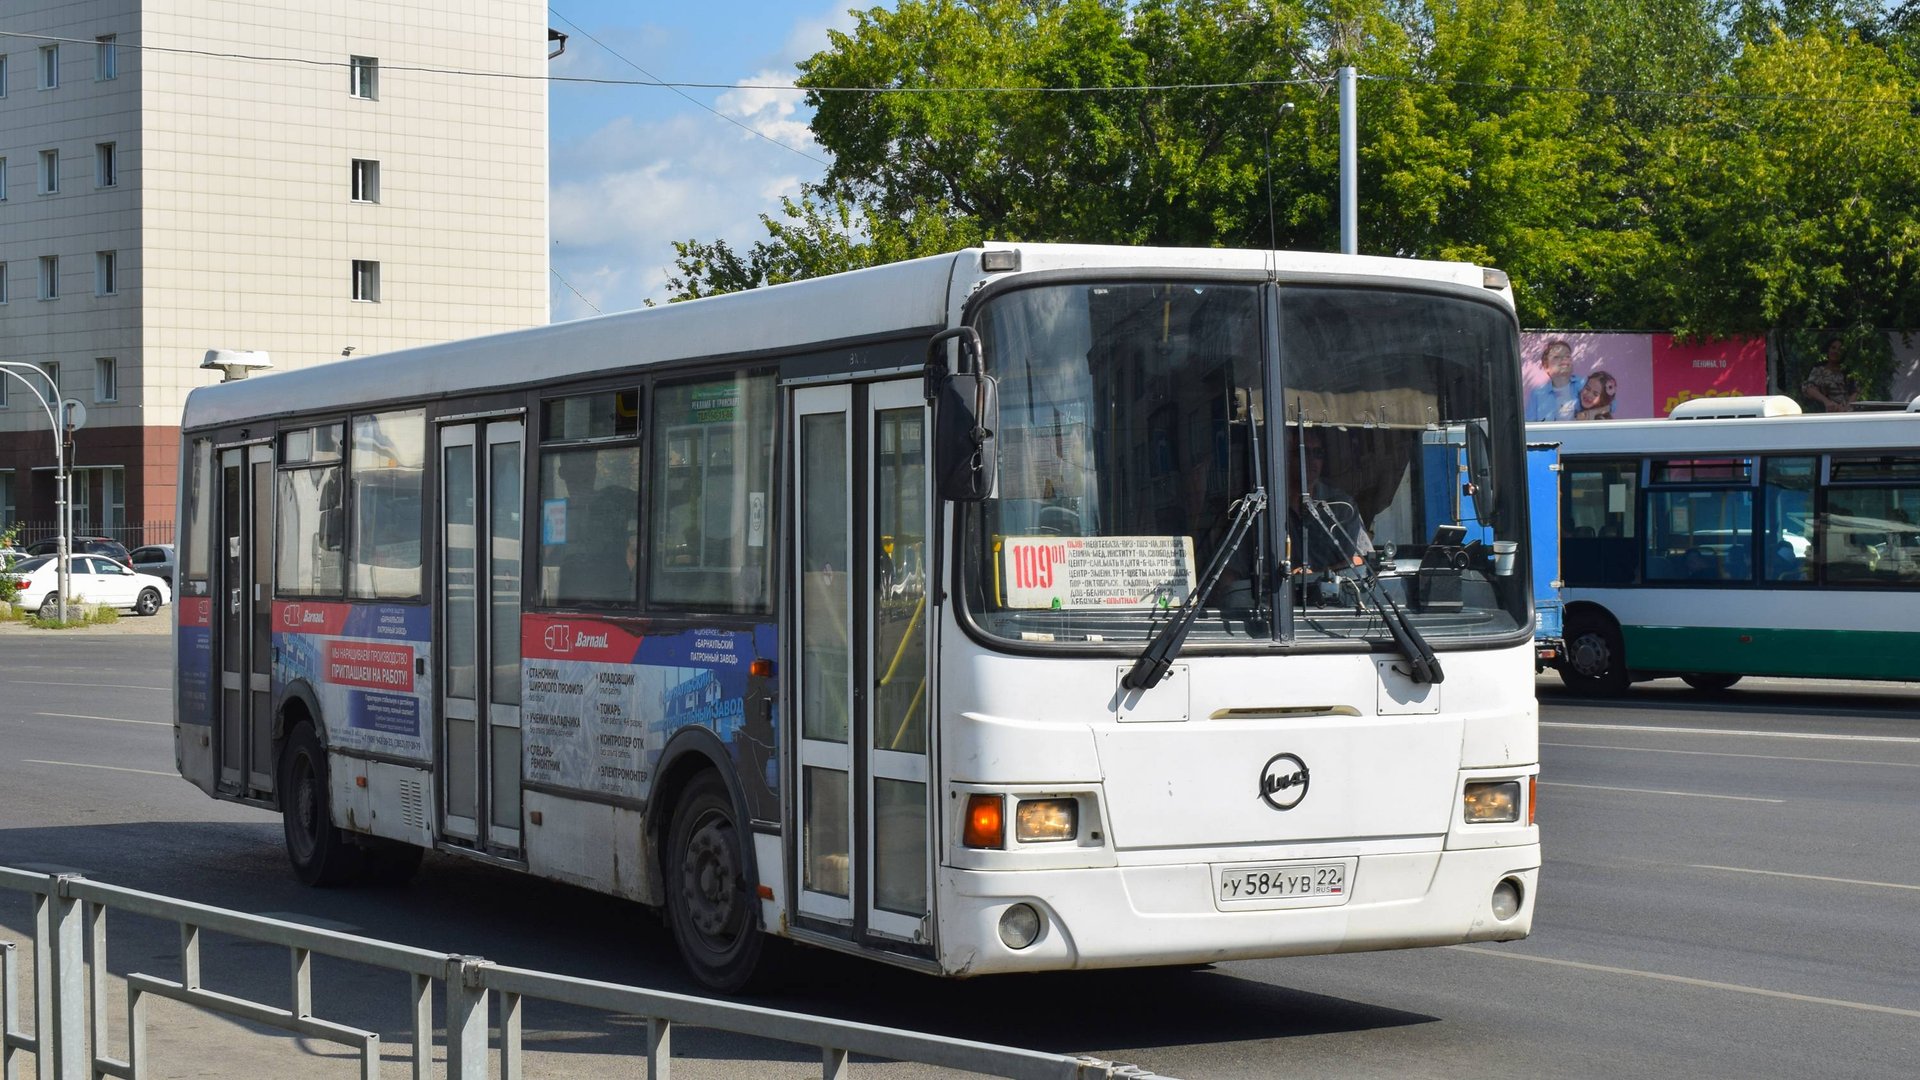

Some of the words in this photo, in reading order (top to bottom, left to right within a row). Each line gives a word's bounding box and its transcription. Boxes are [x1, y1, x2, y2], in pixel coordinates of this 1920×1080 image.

[575, 631, 608, 648] Barnaul
[690, 651, 719, 662] ПАТРОННЫЙ
[331, 663, 372, 682] ПРИГЛАШАЕМ
[372, 667, 382, 683] НА
[382, 668, 408, 686] РАБОТУ!
[529, 680, 557, 693] ШИРОКОГО
[558, 682, 584, 695] ПРОФИЛЯ
[599, 703, 621, 716] ТОКАРЬ
[712, 697, 744, 719] ЗАВОД
[529, 712, 549, 724] УЧЕНИК
[549, 713, 581, 729] НАЛАДЧИКА
[632, 738, 645, 750] ОТК
[600, 765, 648, 782] ЭЛЕКТРОМОНТЕР
[1317, 869, 1337, 885] 22
